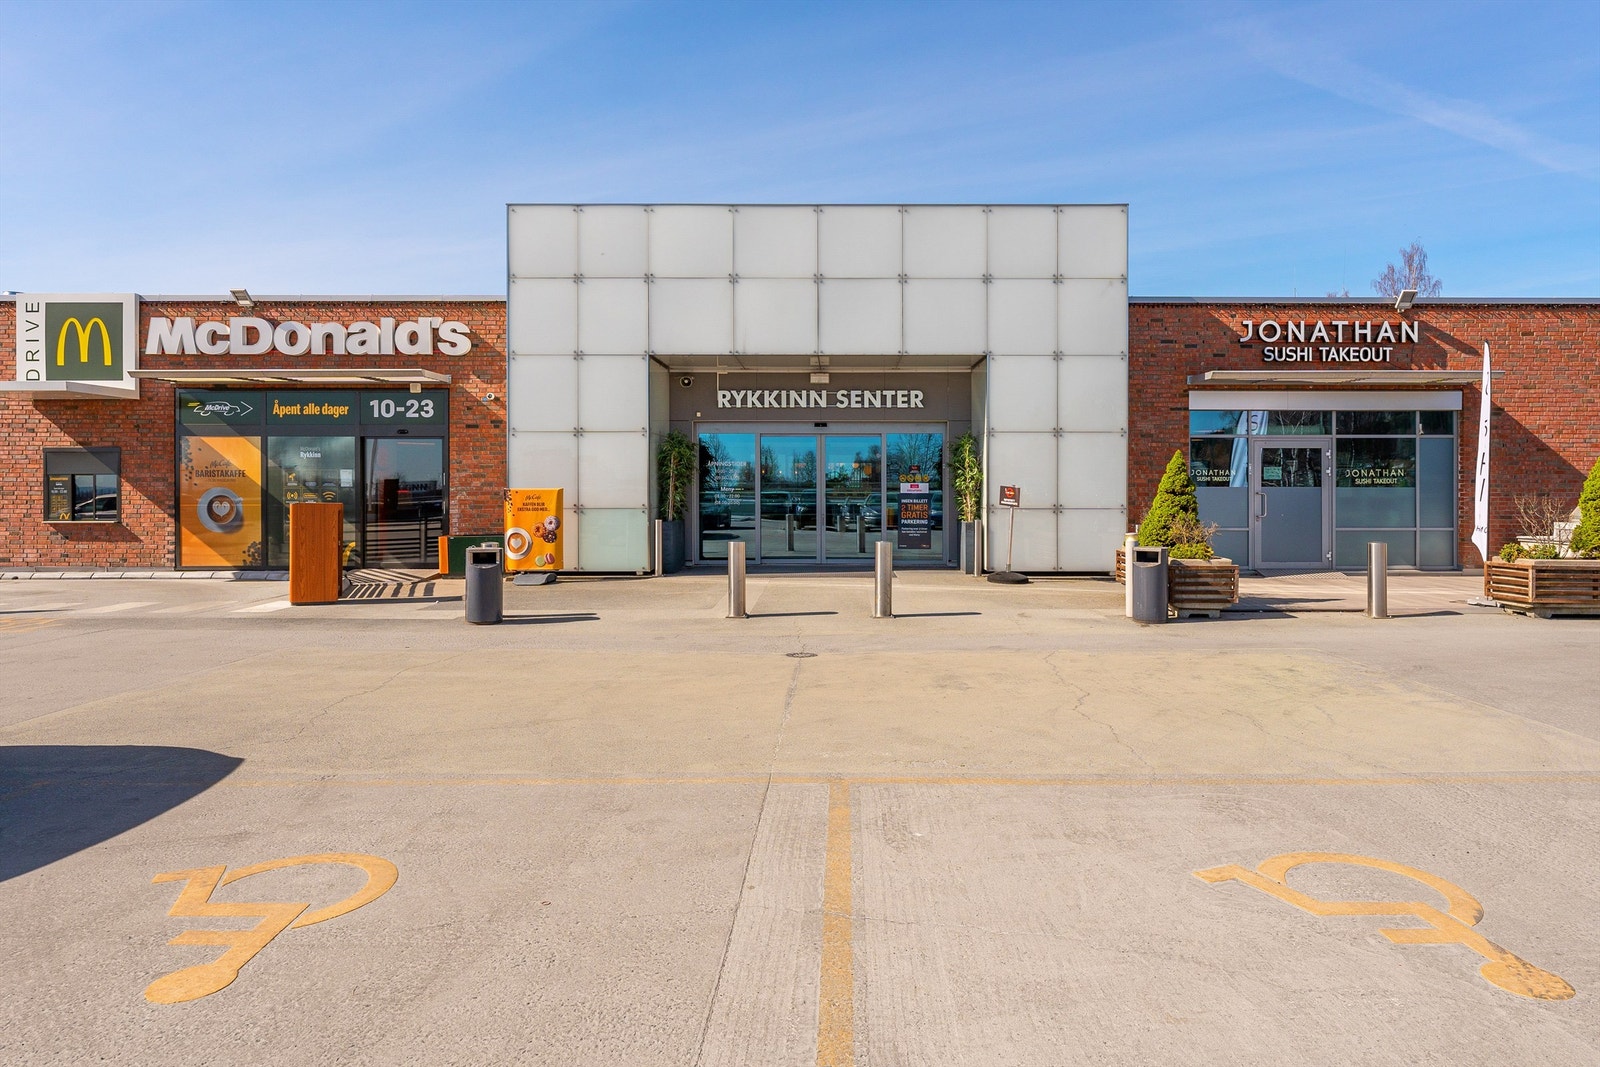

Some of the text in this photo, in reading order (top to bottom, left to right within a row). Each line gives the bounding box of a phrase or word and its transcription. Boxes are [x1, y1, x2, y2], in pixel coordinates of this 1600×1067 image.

[25, 301, 40, 381] DRIVE
[145, 316, 472, 356] McDonald's
[1239, 320, 1419, 343] JONATHAN
[1263, 346, 1393, 362] SUSHI TAKEOUT
[717, 389, 924, 408] RYKKINN SENTER
[272, 399, 350, 419] Åpent alle dager
[369, 399, 434, 418] 10-23
[299, 451, 321, 459] Rykkinn
[195, 469, 246, 478] BARISTAKAFFE
[1345, 469, 1404, 477] JONATHAN
[901, 511, 928, 519] GRATIS
